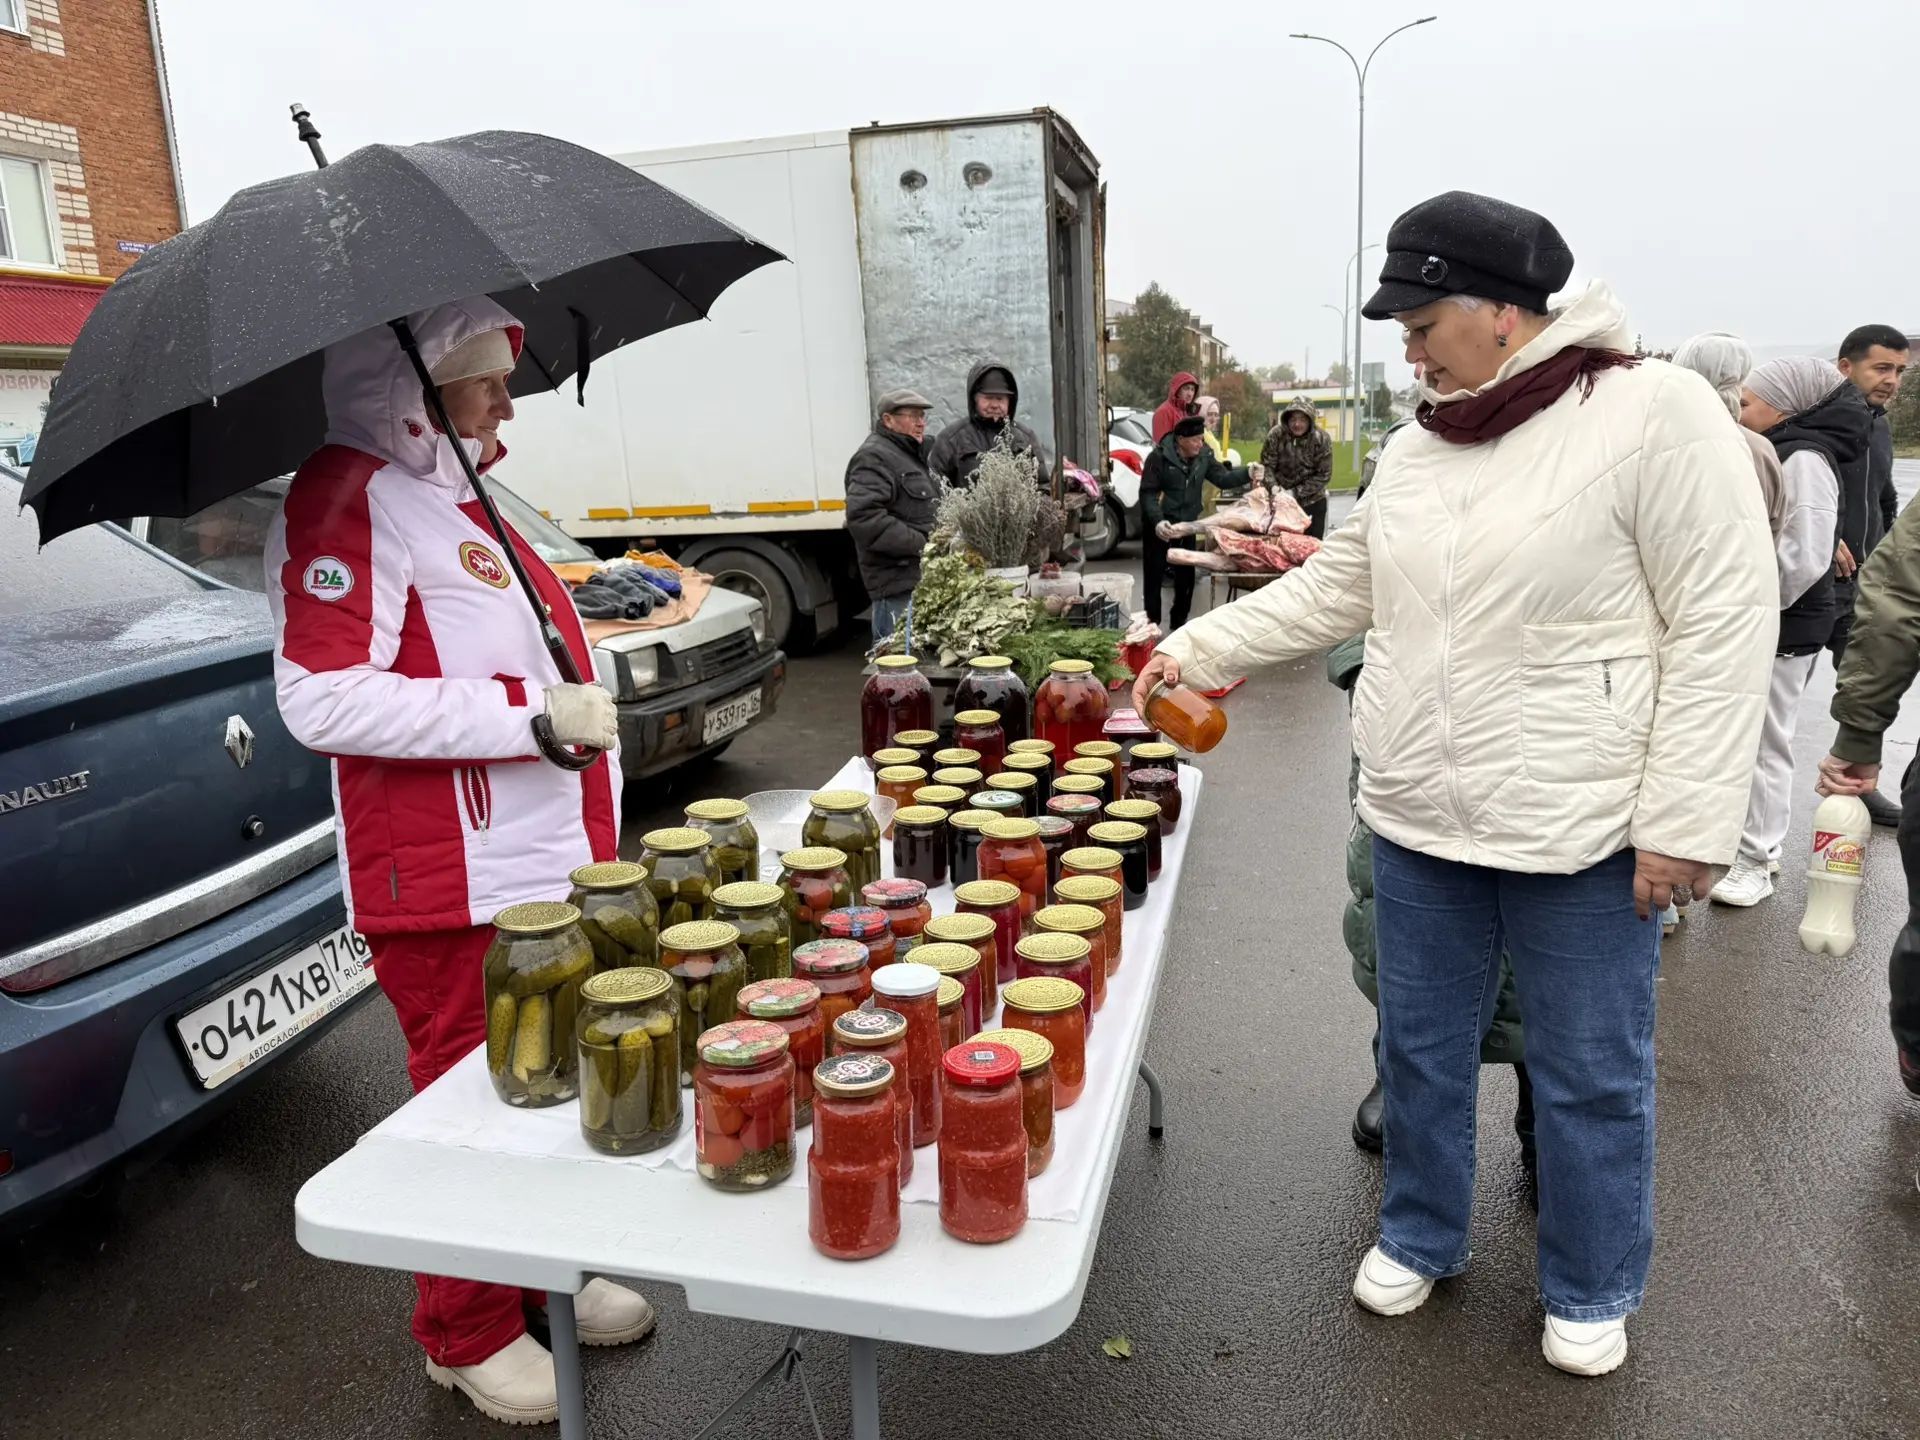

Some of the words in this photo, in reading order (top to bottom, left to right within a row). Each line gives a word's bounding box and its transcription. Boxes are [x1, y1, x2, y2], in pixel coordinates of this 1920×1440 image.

[322, 930, 366, 972] 716
[343, 962, 364, 980] RUS
[201, 962, 330, 1060] О421ХВ
[249, 1024, 300, 1062] АВТОСАЛОН
[301, 1008, 325, 1028] ГУСАР
